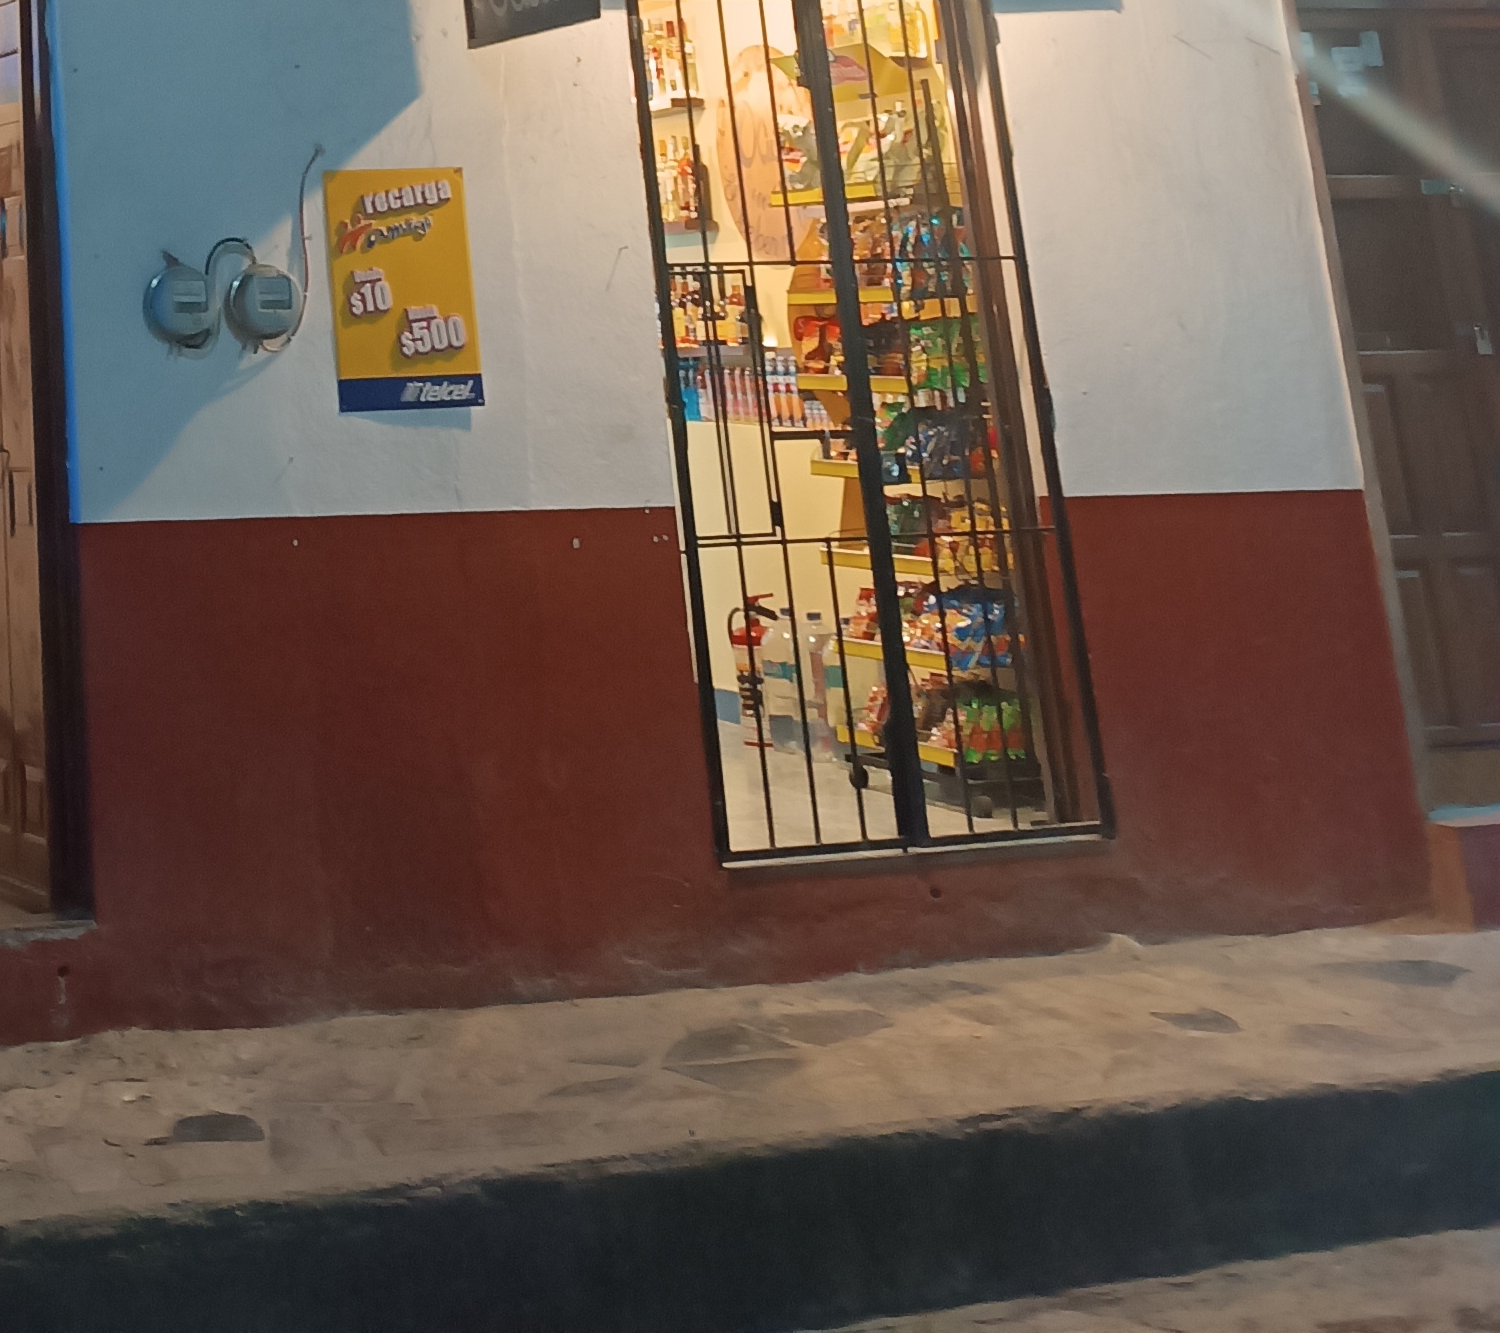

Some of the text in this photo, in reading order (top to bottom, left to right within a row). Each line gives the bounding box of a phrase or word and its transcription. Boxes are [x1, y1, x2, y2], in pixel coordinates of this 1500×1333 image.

[362, 179, 453, 215] recarga
[349, 279, 393, 316] $10
[400, 315, 467, 357] $500
